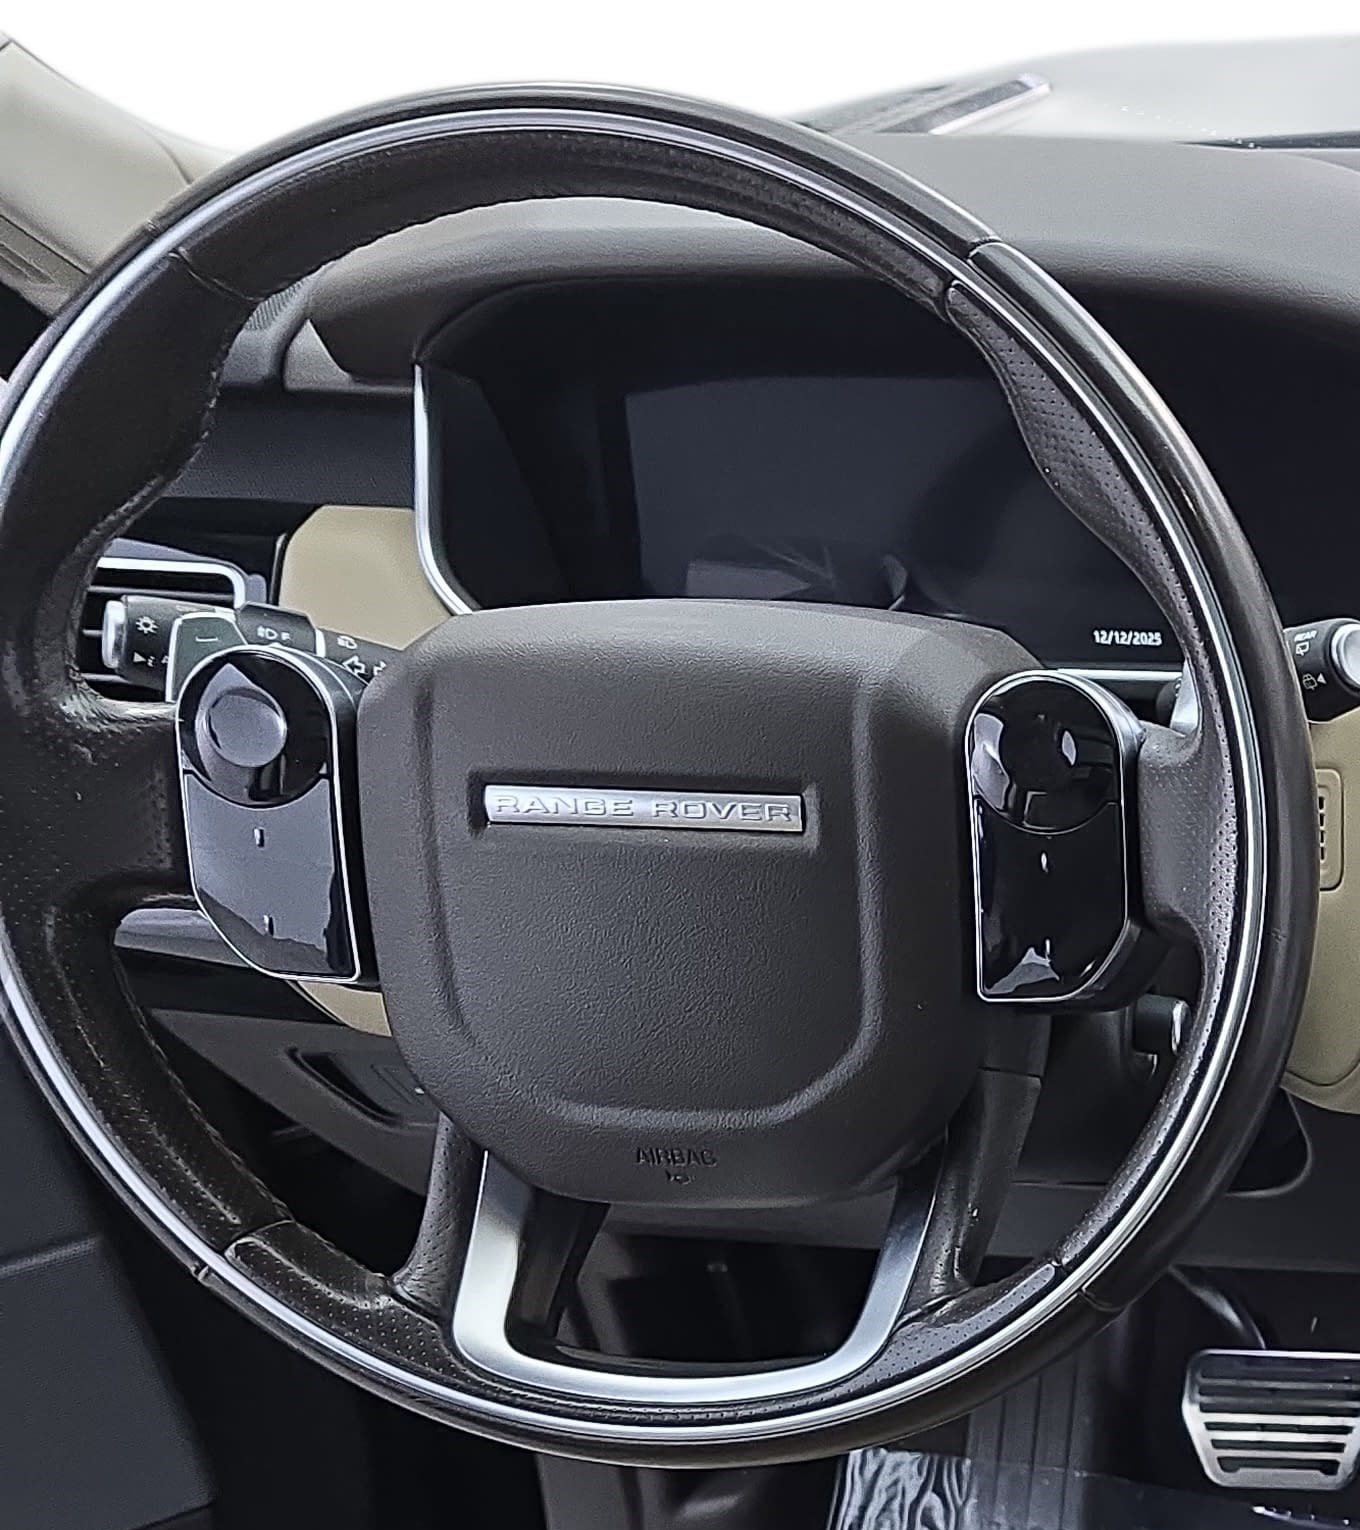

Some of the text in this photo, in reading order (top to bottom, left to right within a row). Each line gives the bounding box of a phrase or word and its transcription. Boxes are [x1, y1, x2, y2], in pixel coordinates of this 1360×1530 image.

[1093, 630, 1162, 646] 12/12/2025
[496, 796, 792, 822] RANGE ROVER
[635, 1147, 718, 1167] AIRBAG
